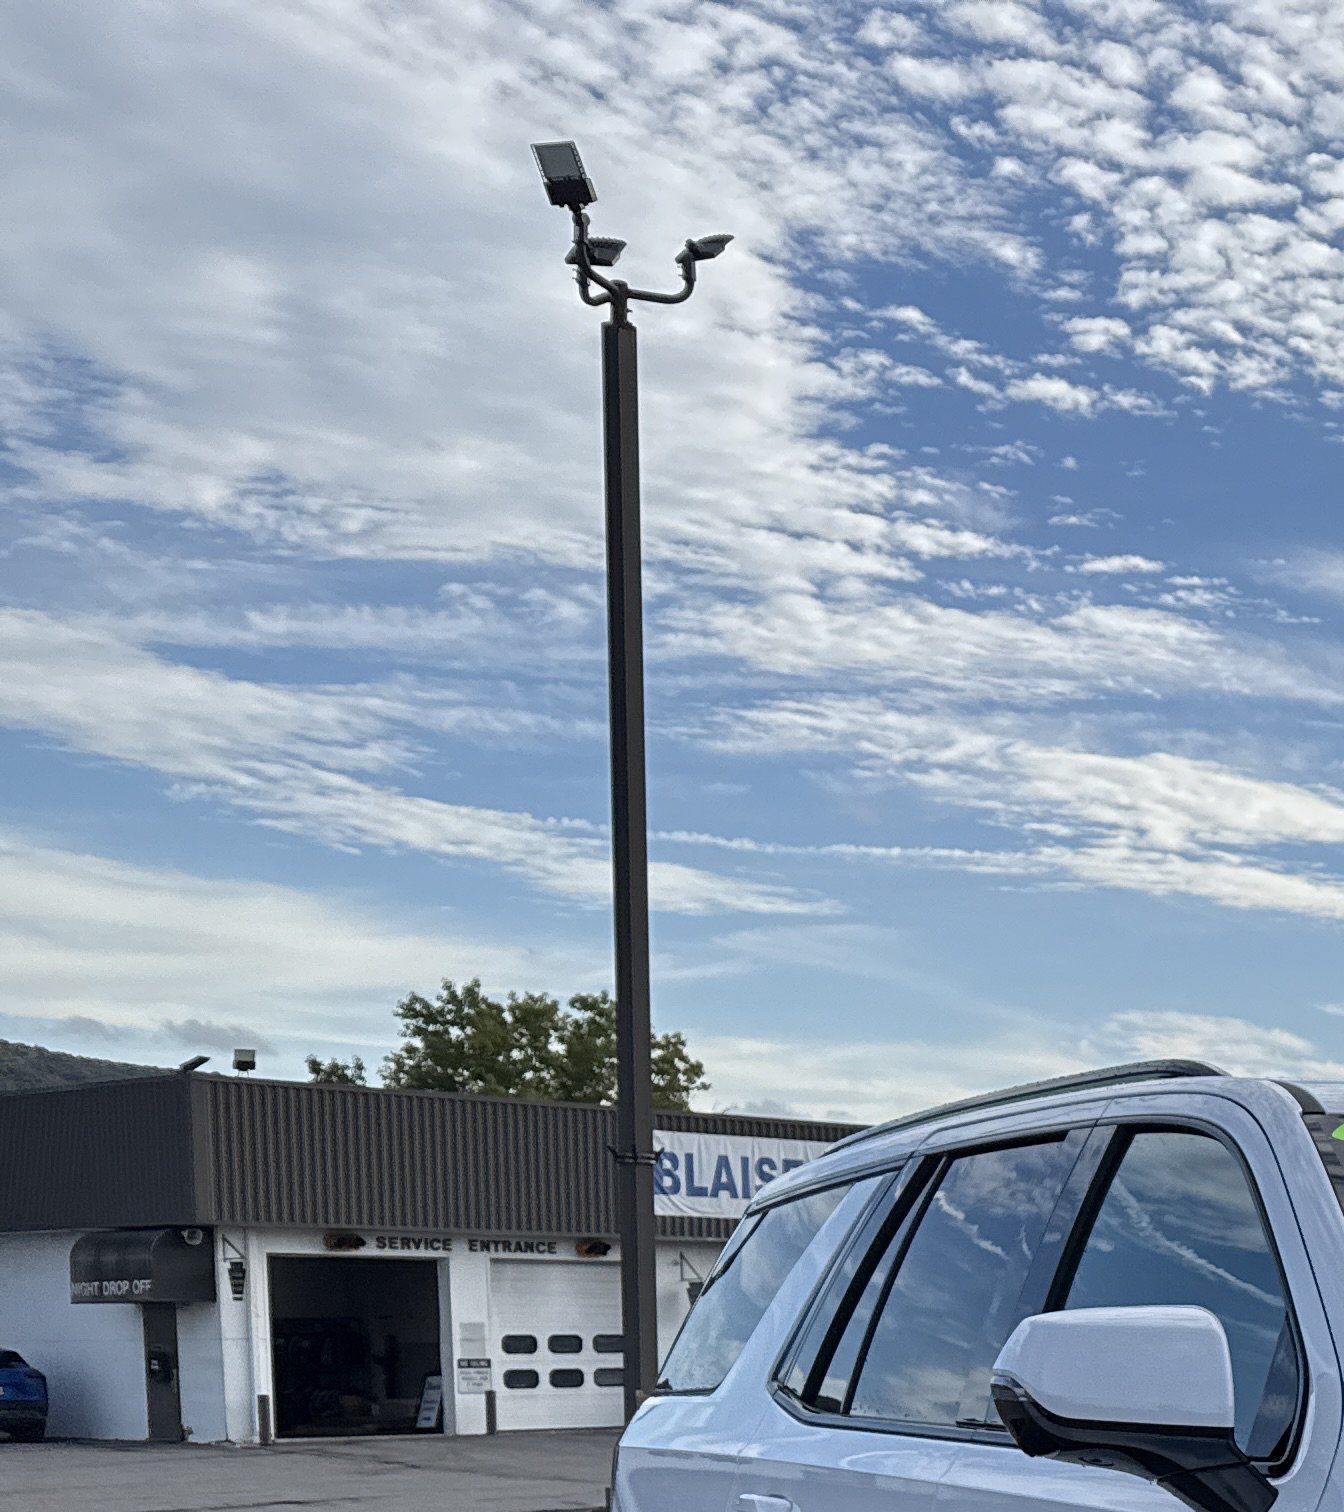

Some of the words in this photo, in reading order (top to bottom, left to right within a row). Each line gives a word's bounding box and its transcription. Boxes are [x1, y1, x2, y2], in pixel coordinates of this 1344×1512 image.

[376, 1236, 452, 1251] SERVICE
[468, 1239, 557, 1254] ENTRANCE
[71, 1281, 100, 1296] NIGHT
[102, 1280, 129, 1296] DROP
[132, 1279, 152, 1294] OFF
